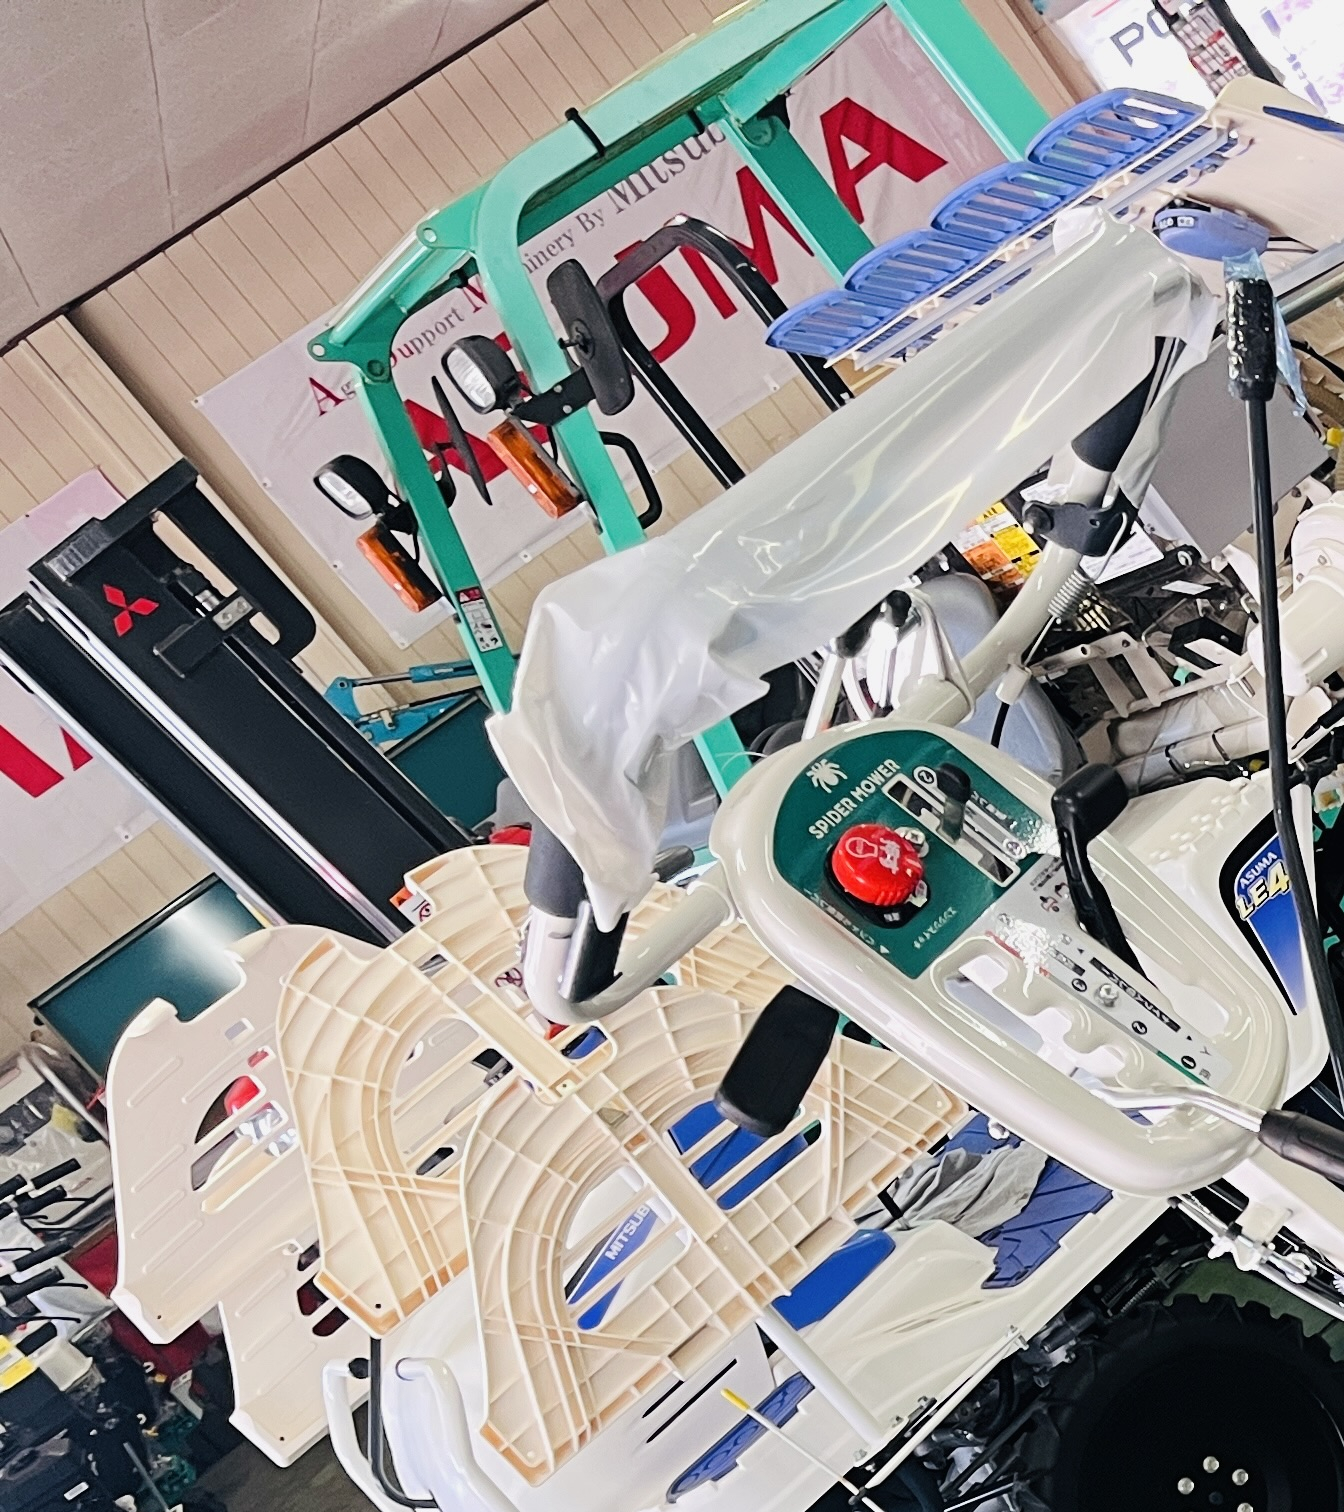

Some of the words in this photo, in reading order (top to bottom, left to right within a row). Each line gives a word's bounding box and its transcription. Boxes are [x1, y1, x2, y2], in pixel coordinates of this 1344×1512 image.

[575, 208, 606, 233] By
[808, 796, 858, 840] SPIDER
[849, 758, 901, 803] MOWER
[1240, 851, 1278, 890] ASUMA
[605, 1204, 651, 1261] MITSUB
